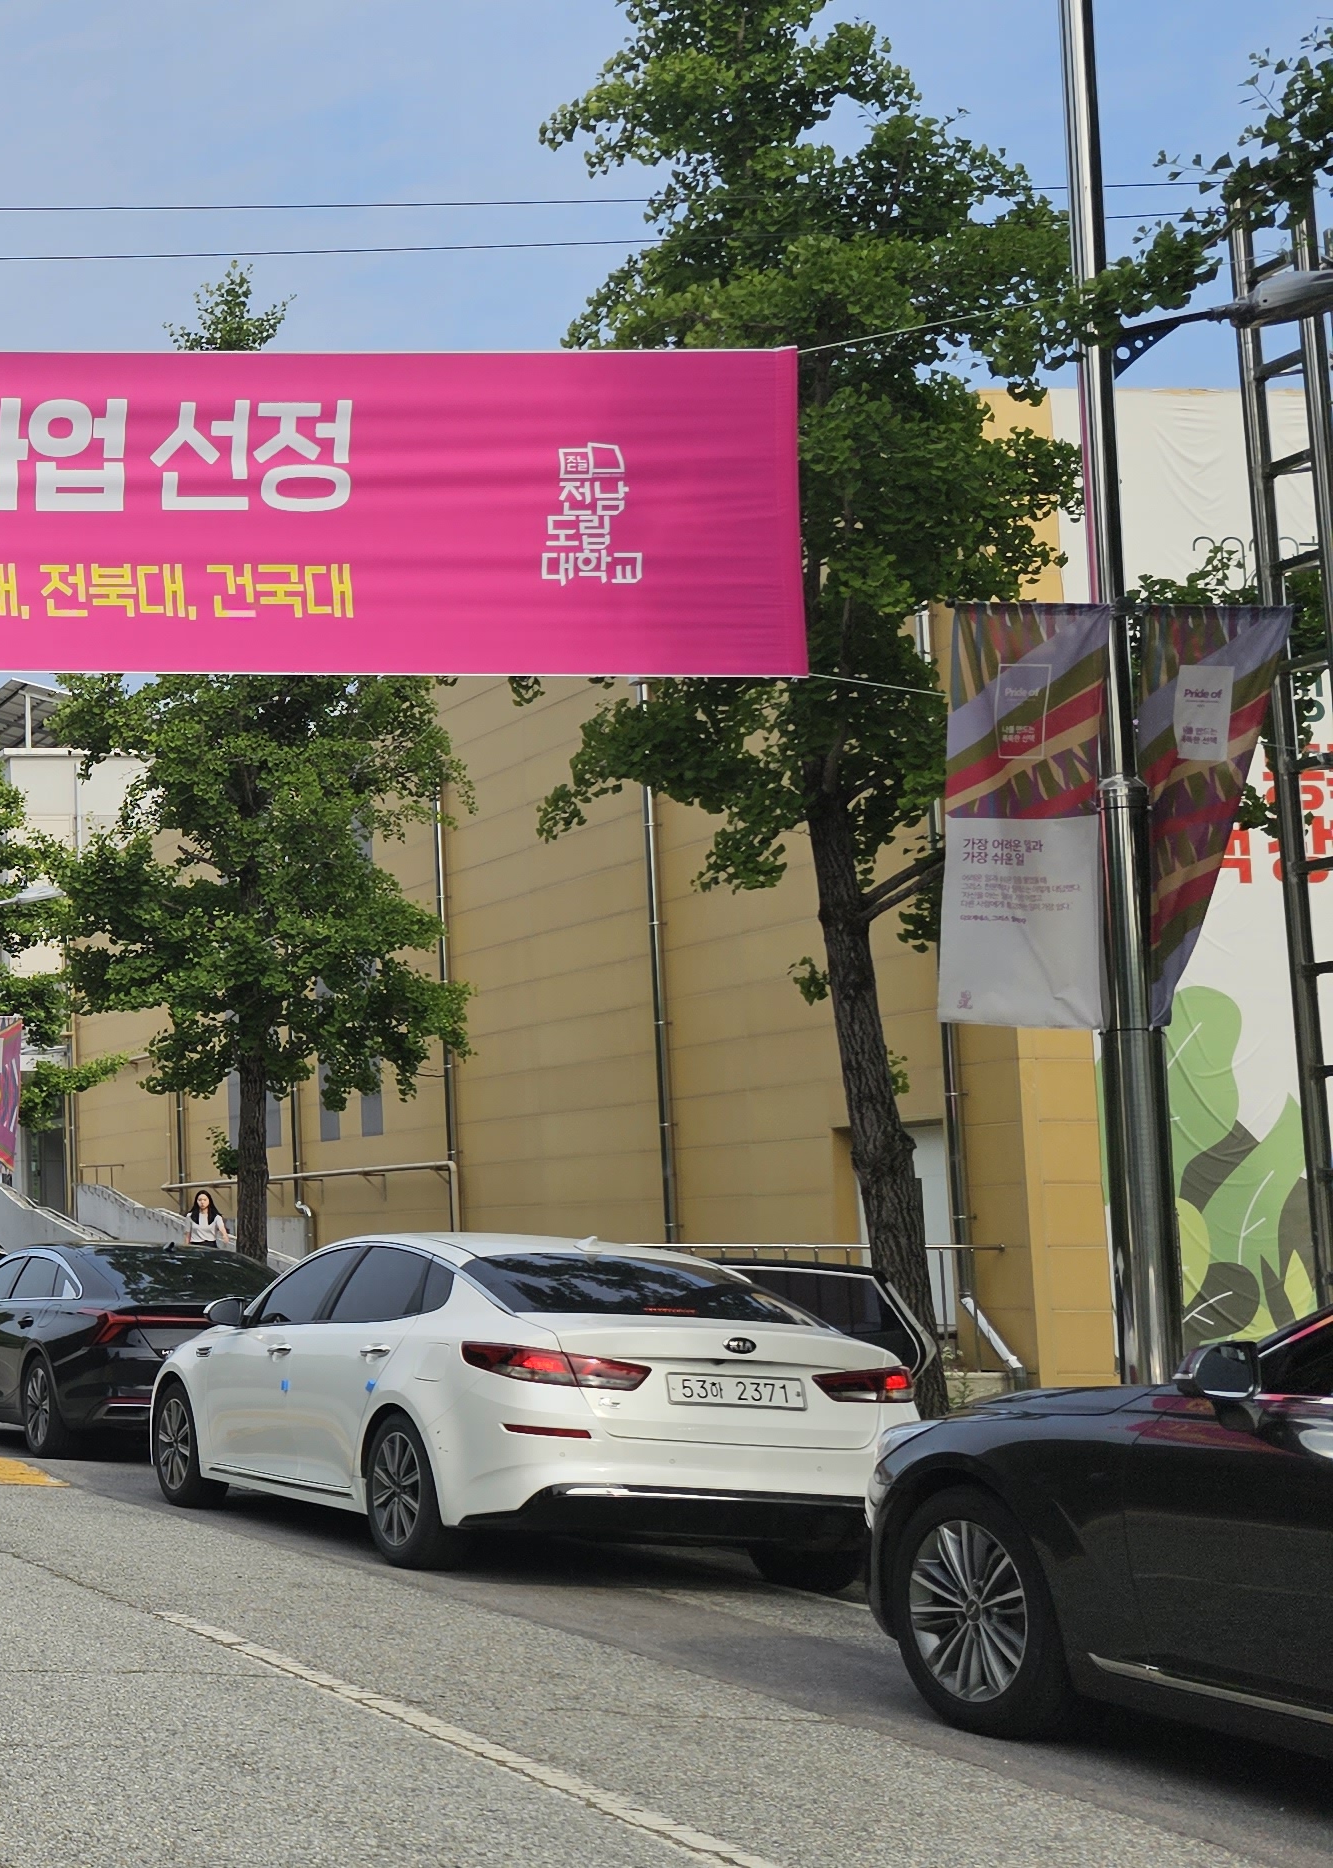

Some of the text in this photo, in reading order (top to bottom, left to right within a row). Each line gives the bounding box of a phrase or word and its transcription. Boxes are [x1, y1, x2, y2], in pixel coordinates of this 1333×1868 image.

[149, 400, 353, 513] 선정
[558, 480, 630, 516] 전남
[545, 515, 611, 550] 도립
[541, 549, 643, 587] 대학교
[40, 564, 197, 621] 전북대,
[206, 563, 354, 619] 건국대
[1005, 687, 1041, 697] Pride of
[1184, 689, 1223, 699] Pride of
[962, 851, 1025, 866] 가장 쉬운 일
[963, 837, 1044, 853] 가장 어려운 일과
[681, 1378, 790, 1404] 53하 2371
